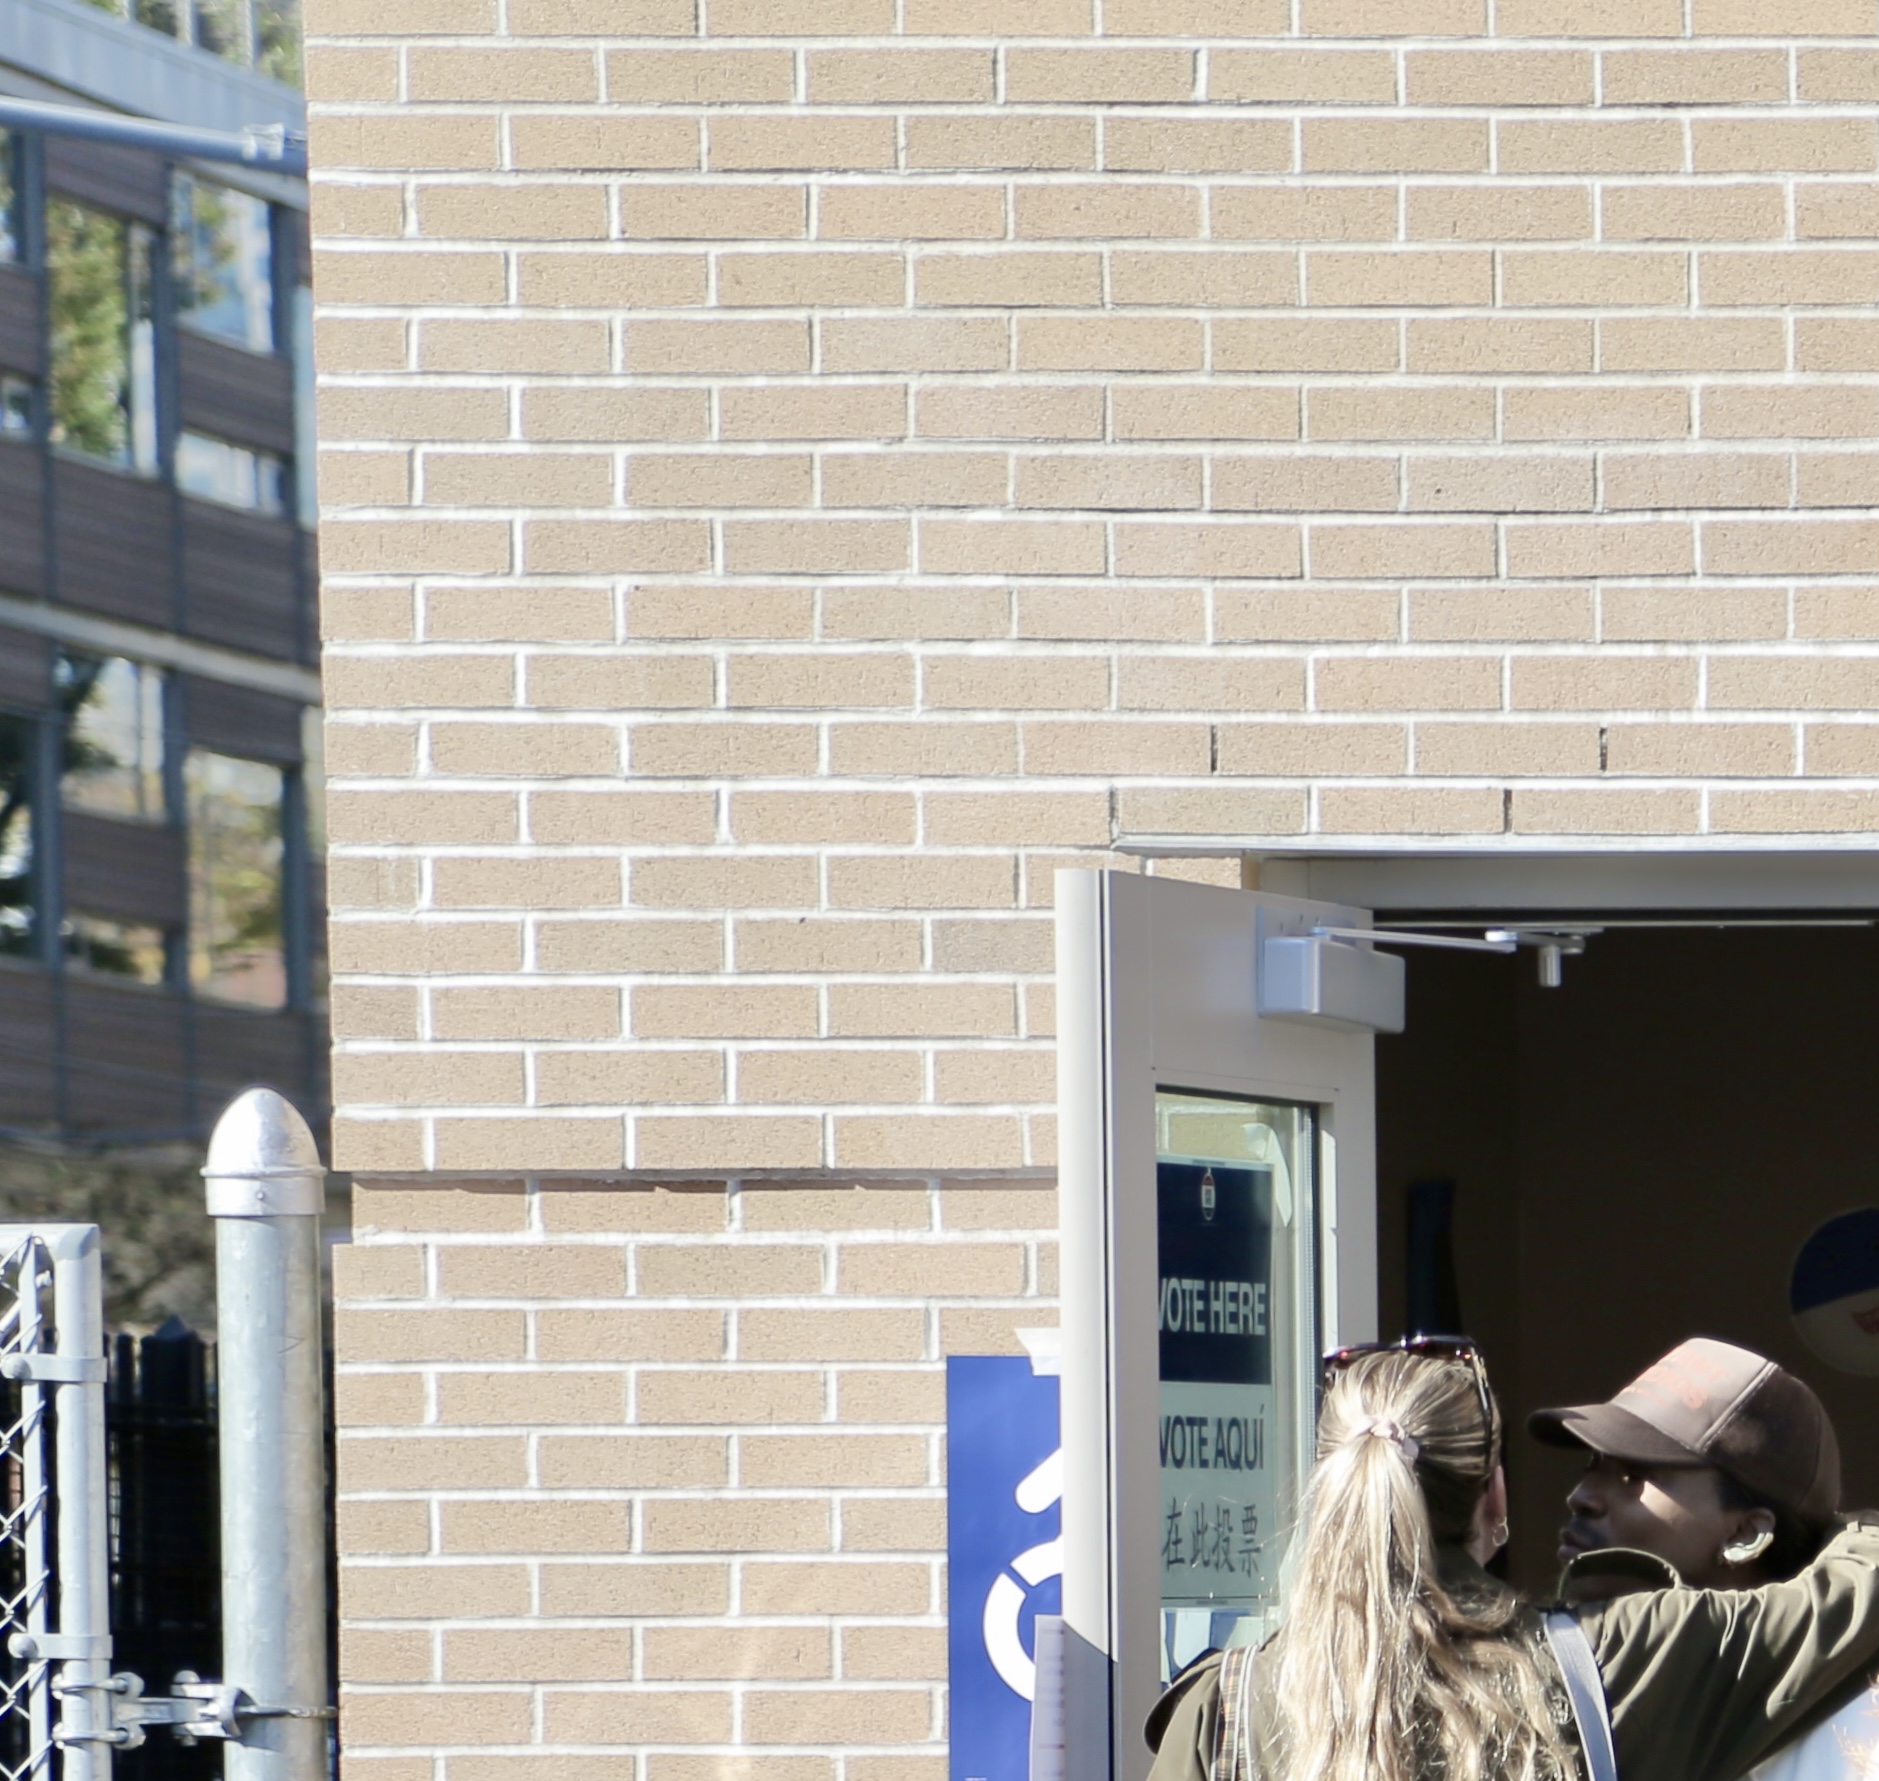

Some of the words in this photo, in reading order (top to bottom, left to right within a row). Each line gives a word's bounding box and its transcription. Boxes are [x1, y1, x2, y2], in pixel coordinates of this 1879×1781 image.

[1210, 1281, 1266, 1336] HERE
[1159, 1415, 1209, 1470] VOTE
[1214, 1403, 1265, 1472] AQUÍ
[1162, 1497, 1261, 1578] 在此投票
